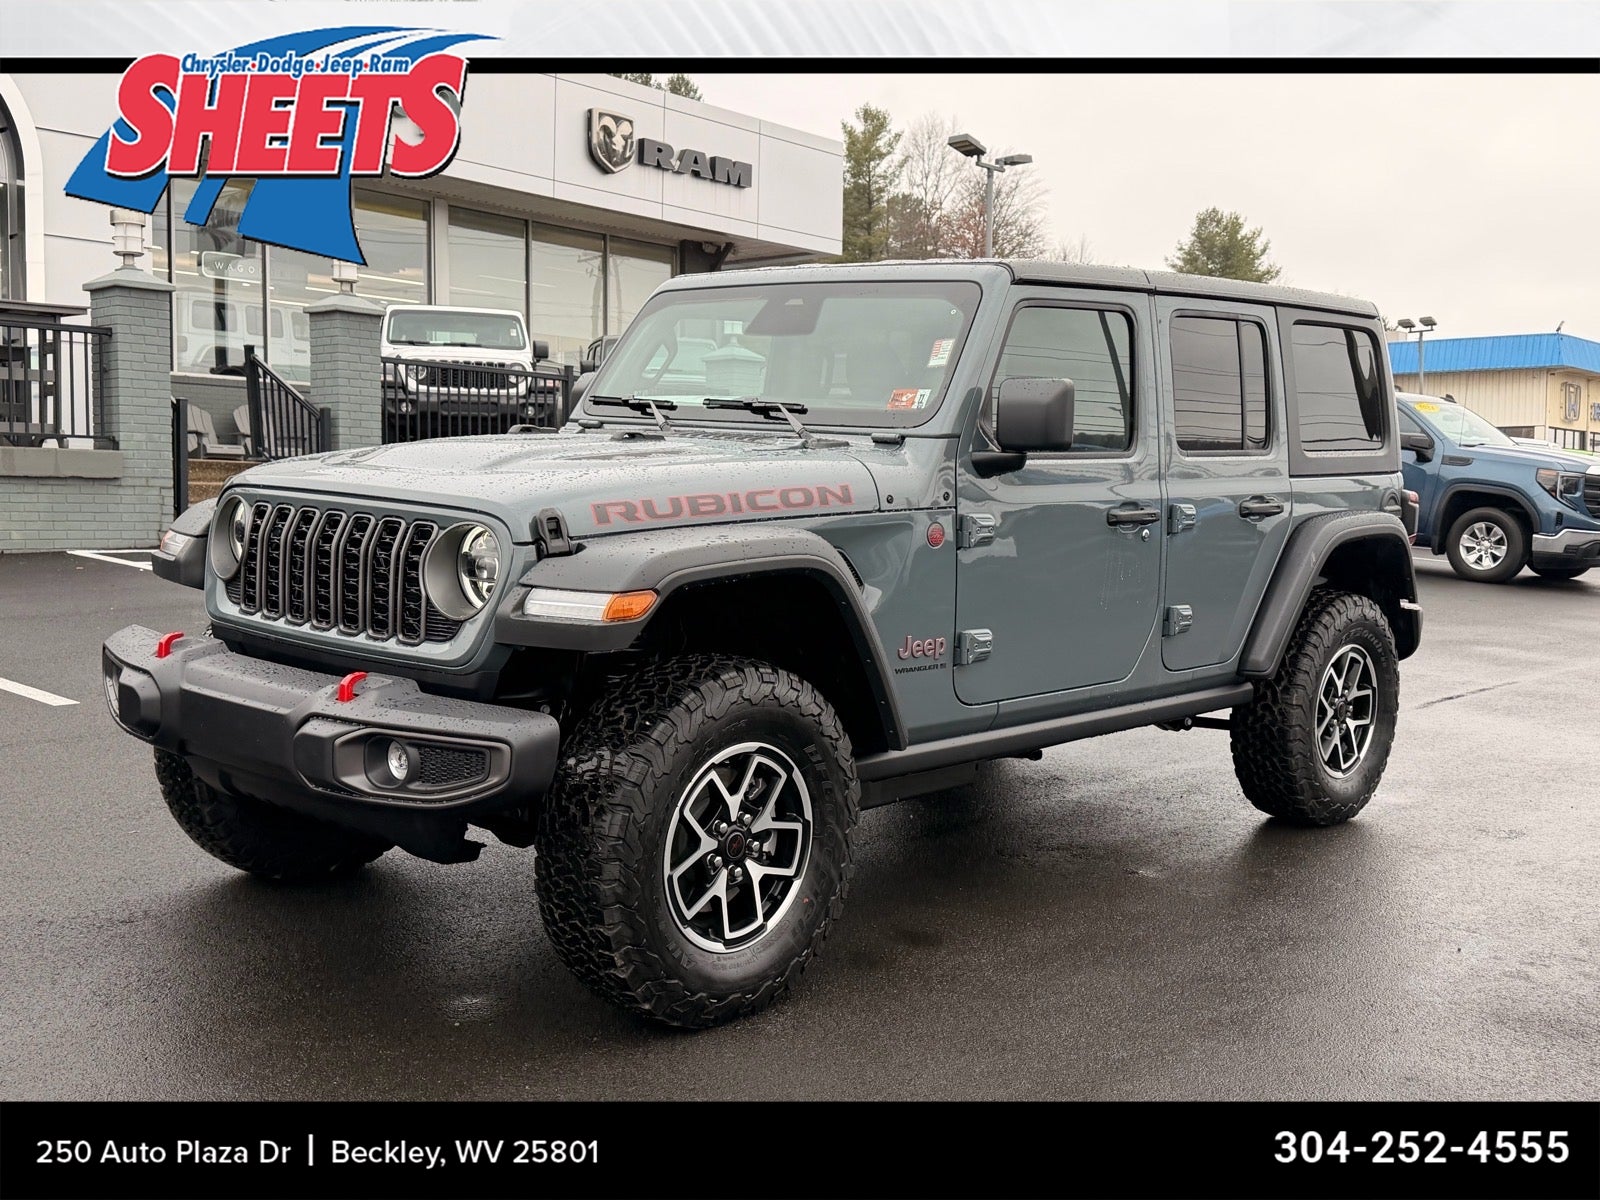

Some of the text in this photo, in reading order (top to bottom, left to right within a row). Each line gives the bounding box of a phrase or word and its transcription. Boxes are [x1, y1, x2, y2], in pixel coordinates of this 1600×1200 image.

[638, 138, 752, 189] RAM
[591, 485, 855, 525] RUBICON
[898, 635, 946, 660] Jeep
[894, 663, 939, 675] WRANGLER
